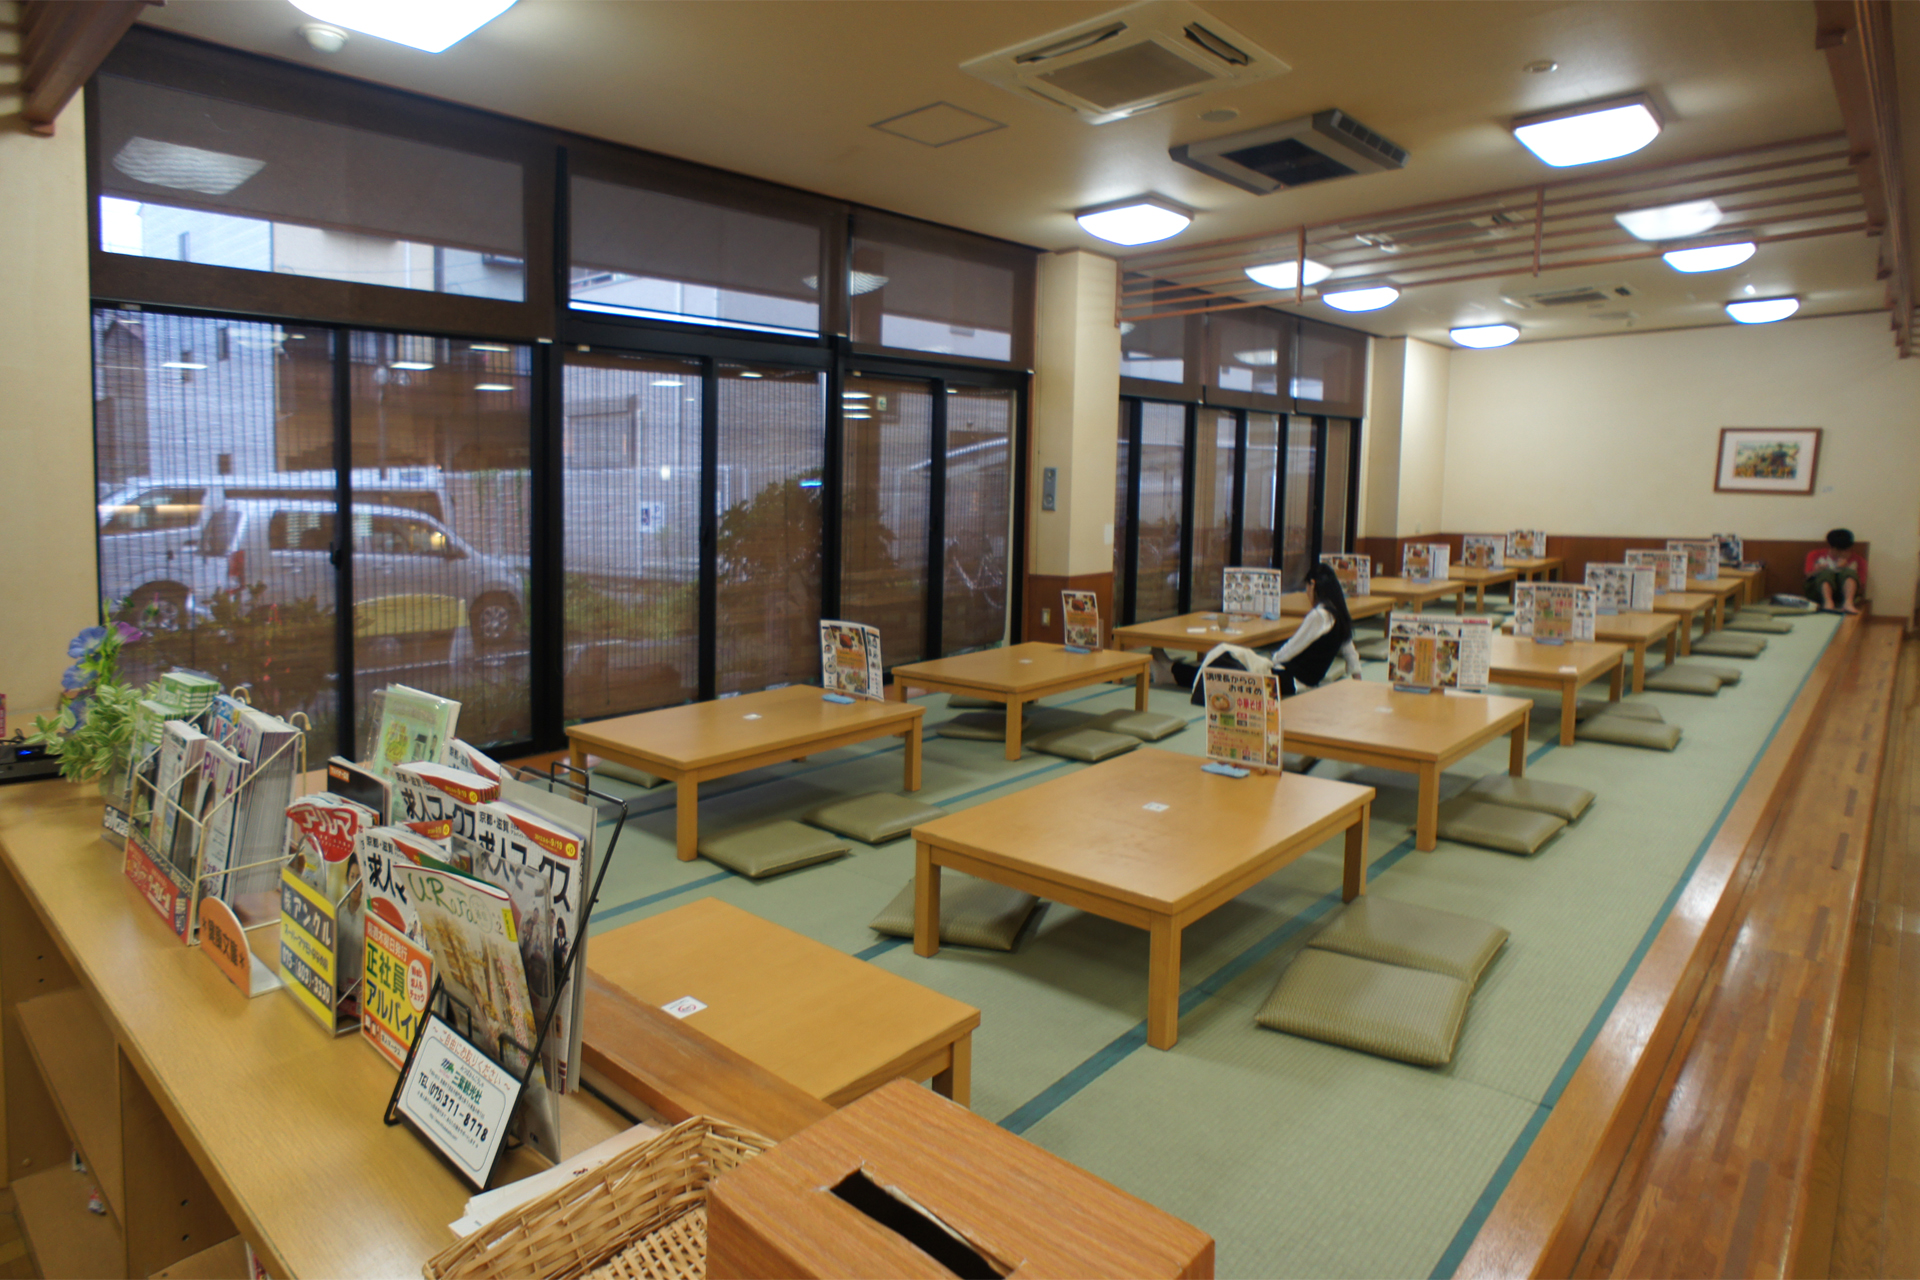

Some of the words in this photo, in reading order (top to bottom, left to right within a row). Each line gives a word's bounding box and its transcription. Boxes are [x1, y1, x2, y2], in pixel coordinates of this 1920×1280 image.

[366, 942, 406, 1001] 正社員
[418, 1071, 429, 1090] TEL
